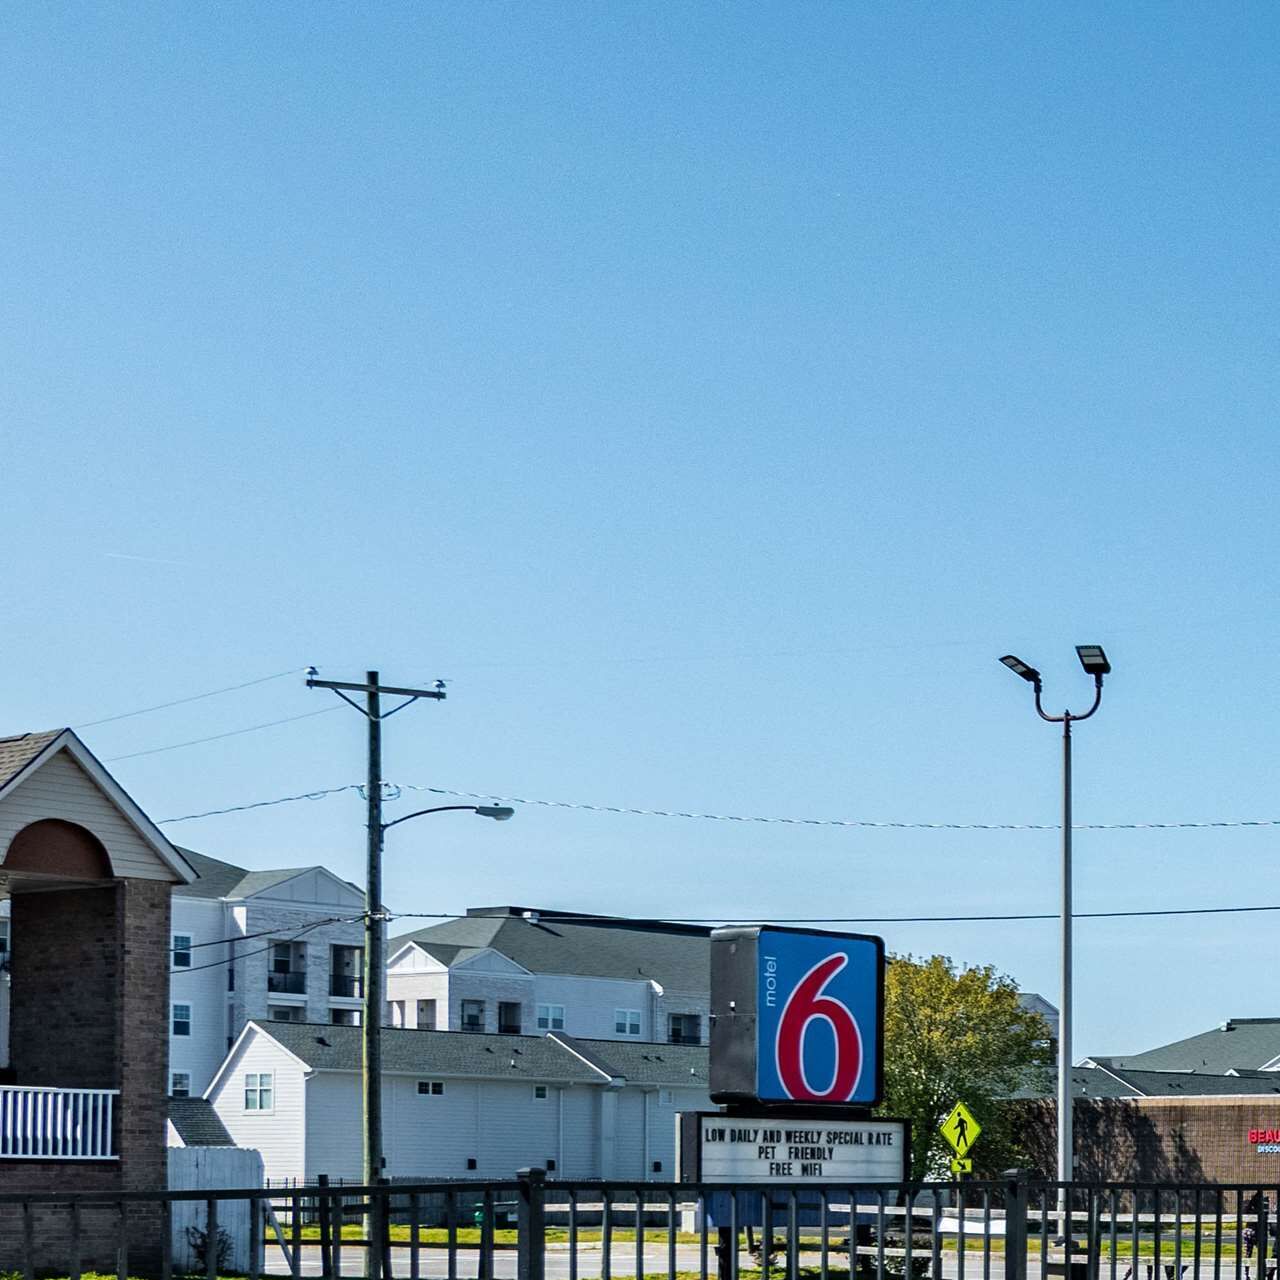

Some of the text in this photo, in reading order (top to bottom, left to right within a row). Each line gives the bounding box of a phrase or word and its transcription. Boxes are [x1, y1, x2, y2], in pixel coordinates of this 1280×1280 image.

[764, 952, 863, 1101] motel 6
[706, 1128, 893, 1146] LOW DAILY AND WEEKLY SPECIAL RATE
[758, 1146, 834, 1160] PET FRIENDLY
[770, 1163, 823, 1176] FREE WIFI
